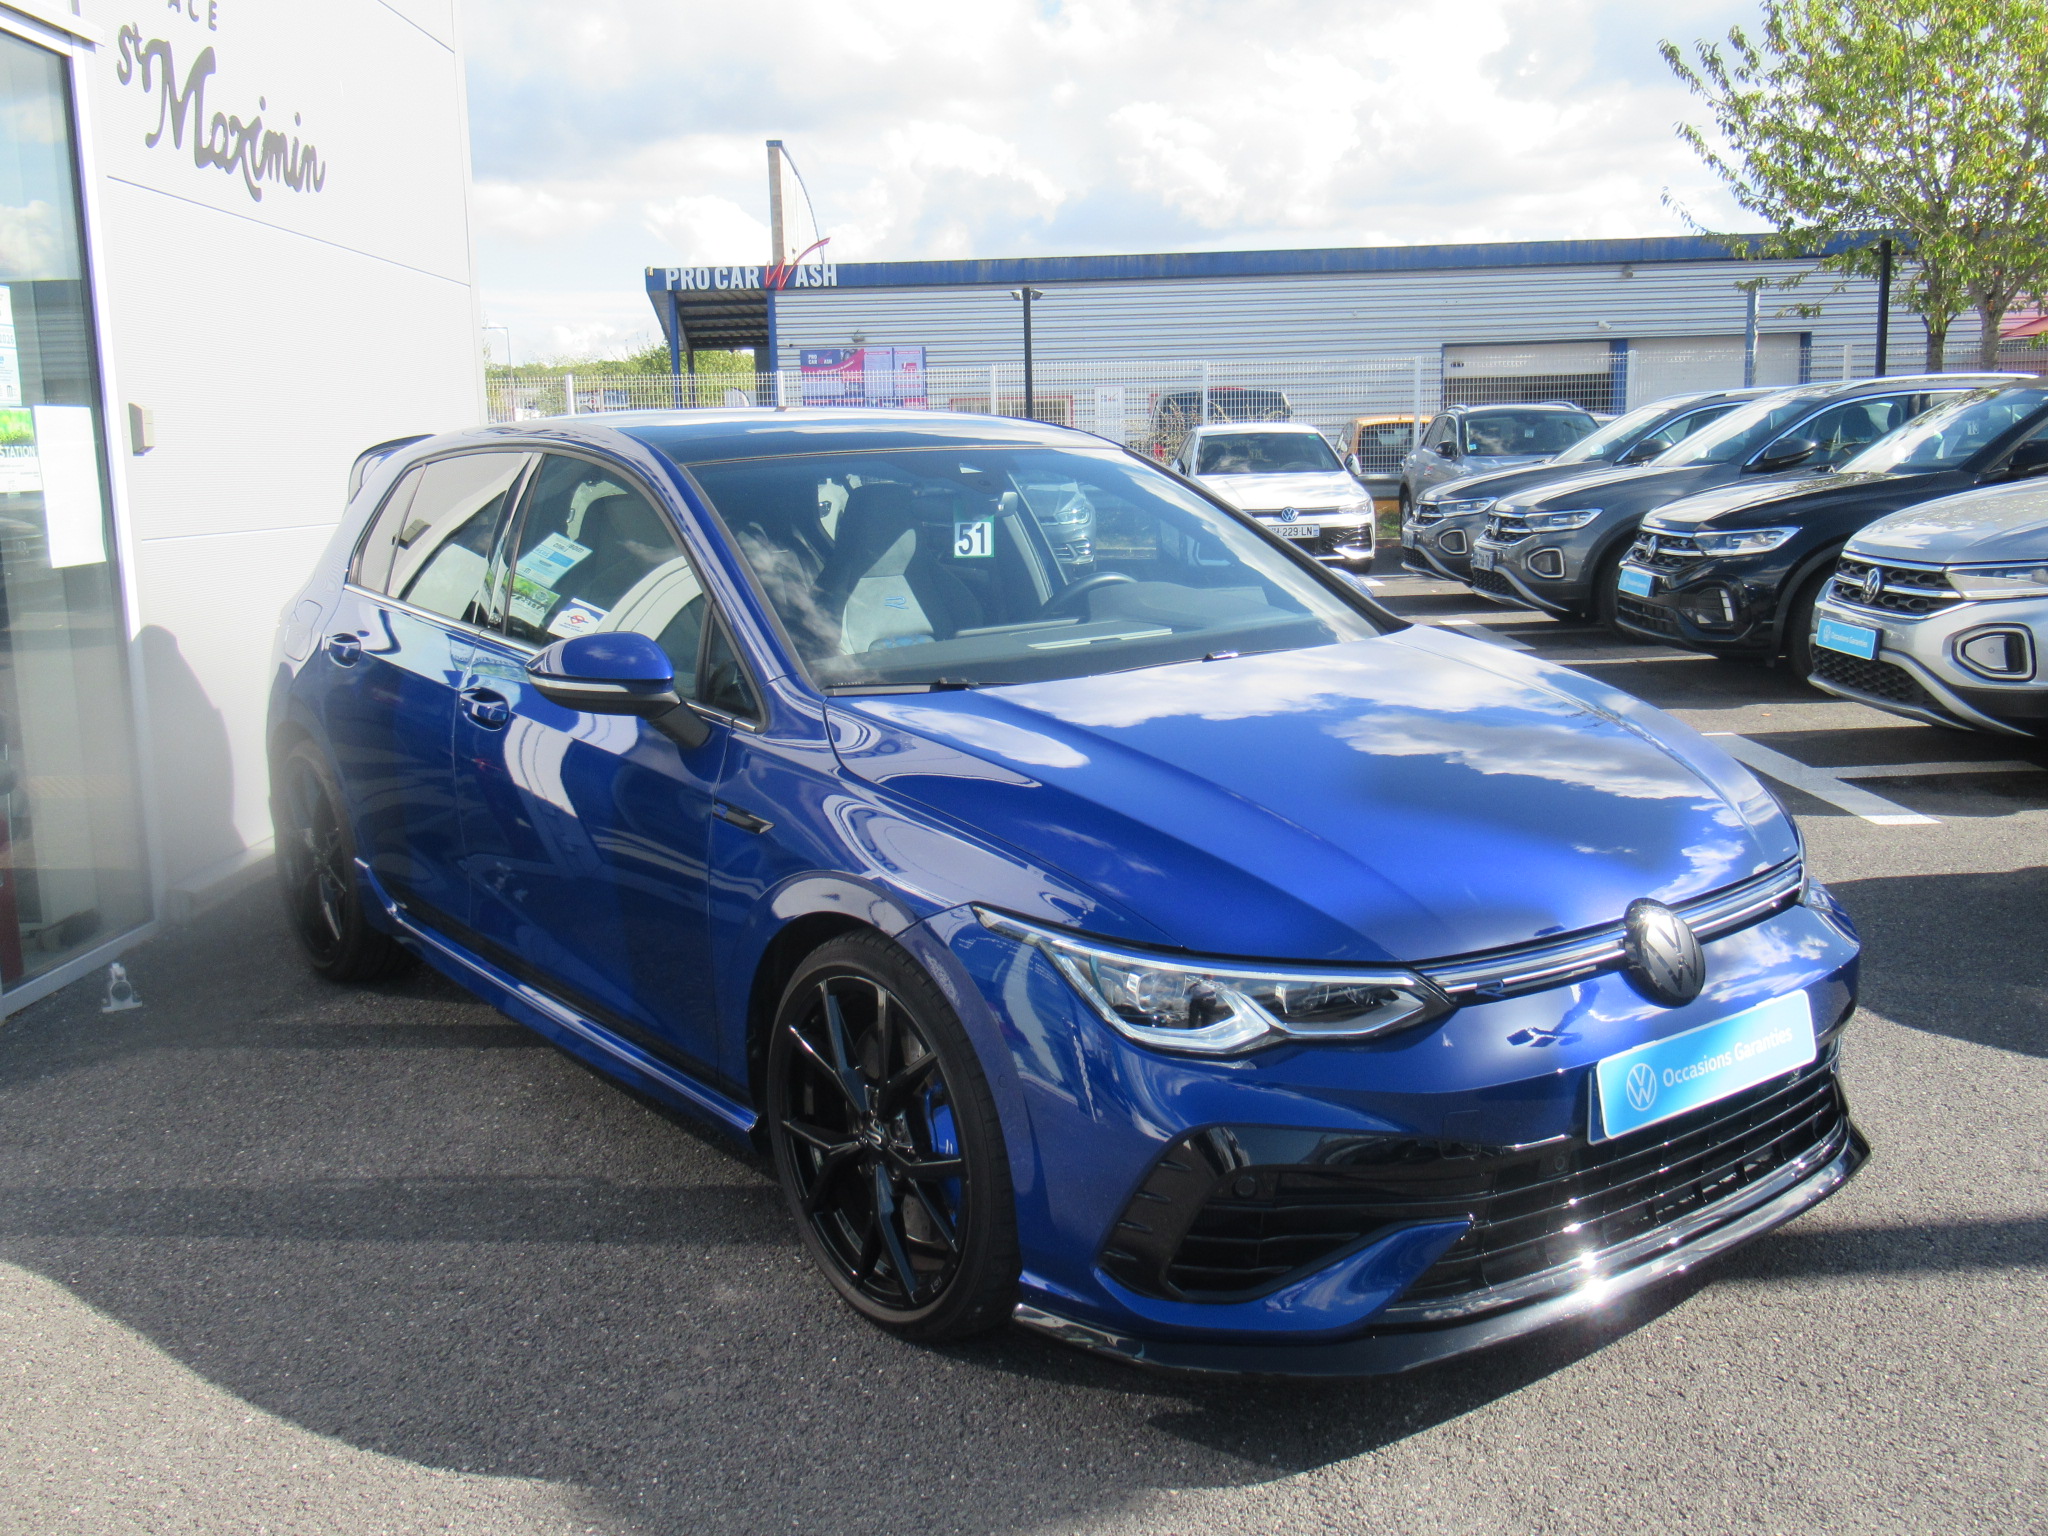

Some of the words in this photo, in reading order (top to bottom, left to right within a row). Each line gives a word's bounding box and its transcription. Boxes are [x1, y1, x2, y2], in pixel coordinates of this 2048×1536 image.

[117, 22, 144, 85] St
[143, 39, 326, 202] Maximin
[665, 267, 711, 291] PRO
[714, 265, 760, 290] CAR
[958, 522, 986, 555] 51
[1662, 1049, 1733, 1088] Occasions
[1733, 1026, 1794, 1062] Garanties
